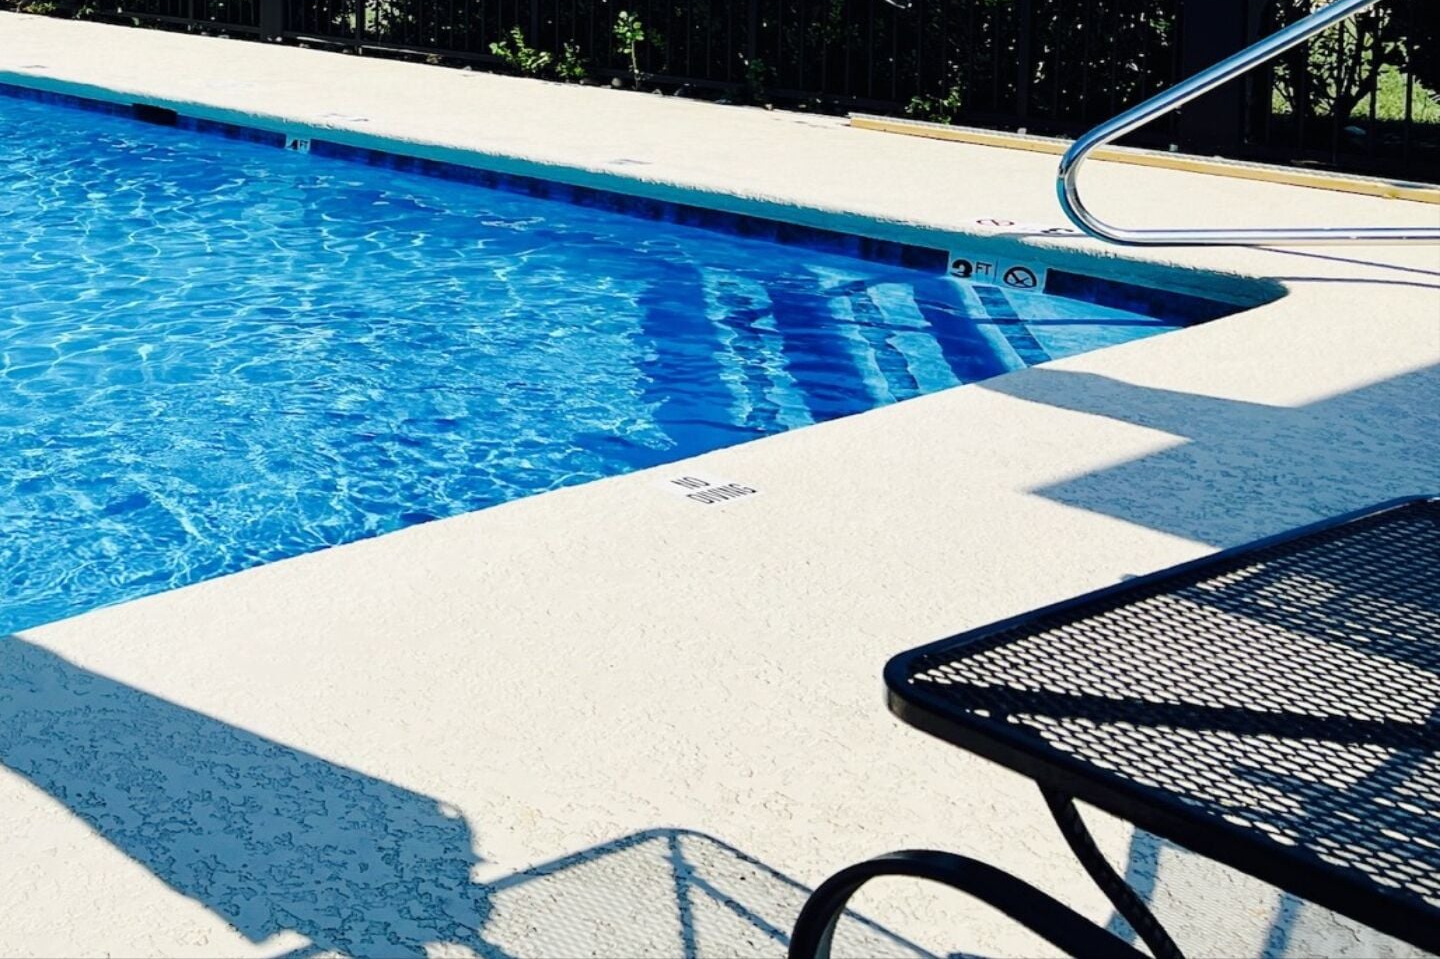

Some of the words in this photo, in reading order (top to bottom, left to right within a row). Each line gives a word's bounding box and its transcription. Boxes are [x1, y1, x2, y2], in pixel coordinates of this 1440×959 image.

[976, 262, 992, 275] FT
[670, 476, 710, 490] NO
[686, 483, 757, 504] DIVING
